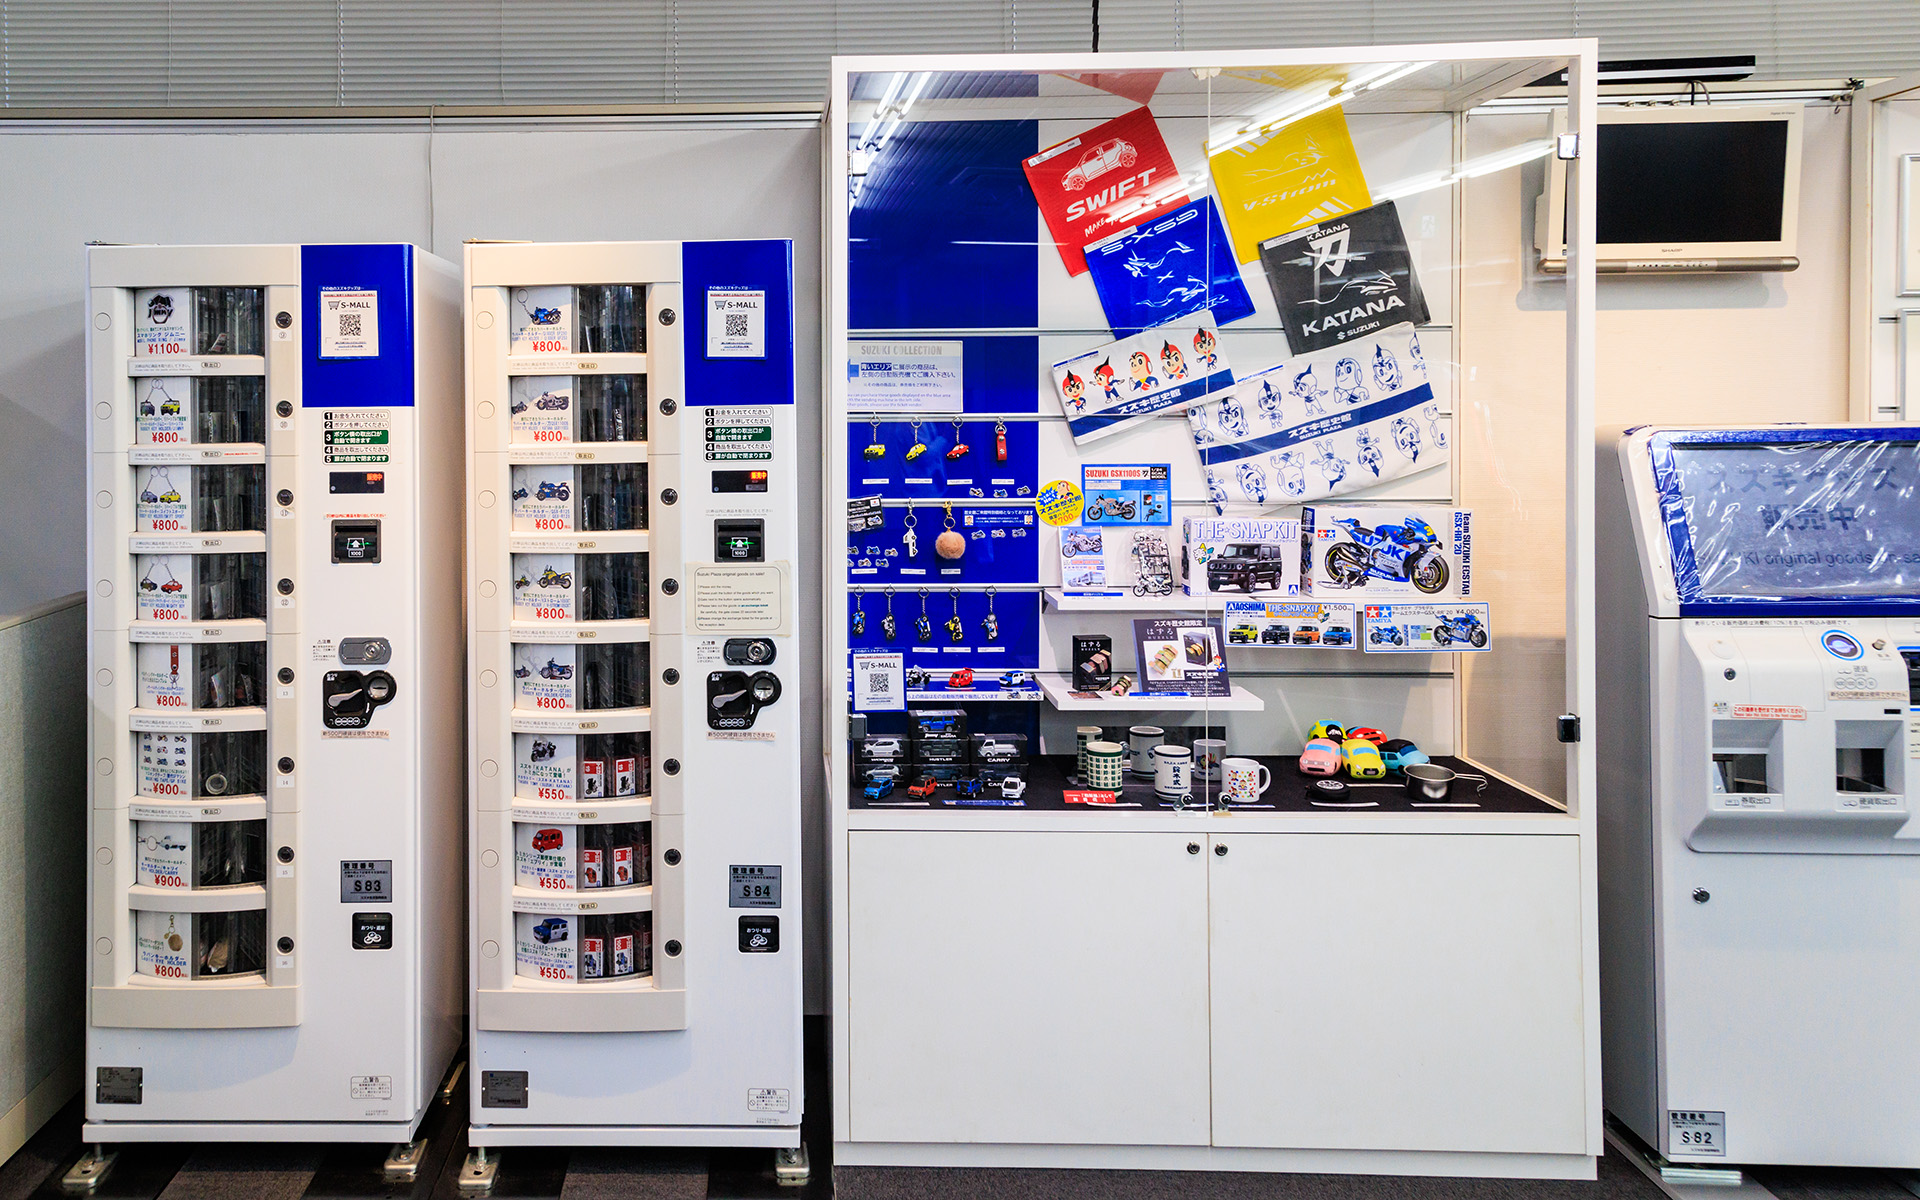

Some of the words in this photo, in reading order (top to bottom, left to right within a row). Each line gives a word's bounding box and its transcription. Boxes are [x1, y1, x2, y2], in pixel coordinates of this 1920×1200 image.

[1066, 168, 1156, 222] SWIFT
[1306, 223, 1350, 242] KATANA
[1302, 295, 1406, 337] KATANA
[1347, 321, 1380, 336] SUZUKI
[533, 341, 561, 352] ¥800
[893, 345, 942, 355] CLLECTION
[1118, 388, 1182, 415] スズキ歴史館
[1288, 414, 1352, 438] スズキ歴史館
[152, 432, 178, 443] ¥800
[534, 431, 562, 442] ¥800
[535, 519, 564, 530] ¥800
[1052, 513, 1073, 525] ¥700
[1463, 512, 1472, 533] Team
[153, 520, 178, 531] ¥800
[1194, 522, 1224, 539] THE
[1229, 522, 1299, 539] SNAPKIT
[1424, 526, 1433, 536] 3
[1463, 534, 1471, 566] SUZUKI
[1764, 552, 1822, 569] original
[1826, 552, 1872, 569] goods
[1370, 568, 1395, 580] SUZUKI
[1462, 567, 1470, 595] ECSTAR
[1236, 603, 1265, 611] AOSHIMA
[1286, 605, 1320, 613] SNAPKIT
[153, 609, 179, 620] ¥800
[536, 608, 565, 619] ¥800
[156, 695, 181, 707] ¥800
[537, 697, 565, 709] ¥800
[153, 783, 178, 795] ¥900
[538, 788, 564, 800] ¥550
[155, 875, 181, 888] ¥900
[540, 877, 566, 889] ¥550
[155, 965, 181, 978] ¥800
[540, 966, 566, 979] ¥550
